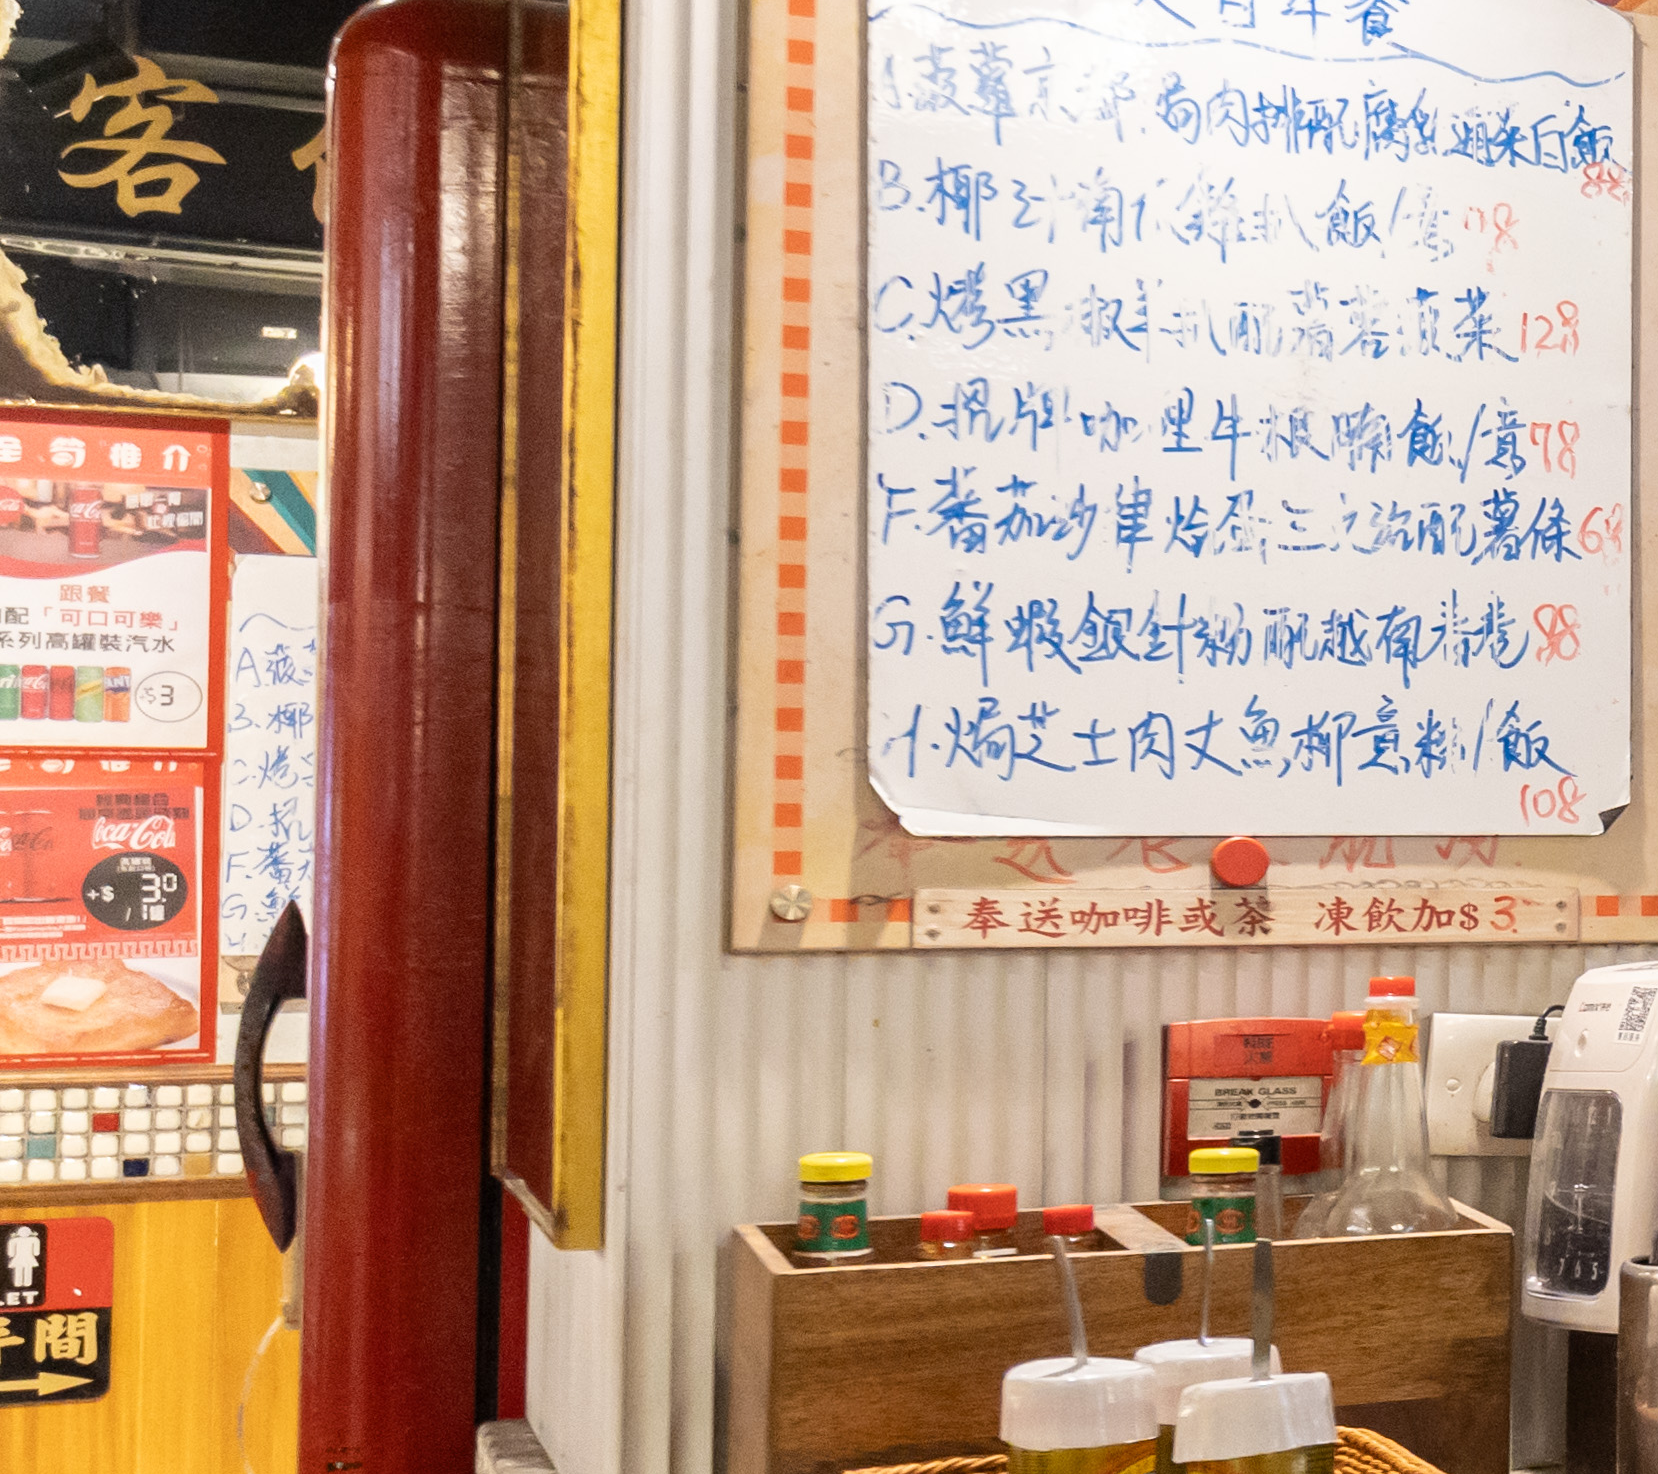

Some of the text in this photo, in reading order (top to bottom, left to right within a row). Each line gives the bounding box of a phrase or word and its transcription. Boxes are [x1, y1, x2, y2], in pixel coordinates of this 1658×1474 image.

[59, 584, 110, 603] 跟餐
[1520, 776, 1588, 824] 108
[966, 896, 1276, 939] 奉送咖啡或茶
[1214, 1086, 1298, 1097] BREAK GLASS
[0, 1291, 40, 1307] ET
